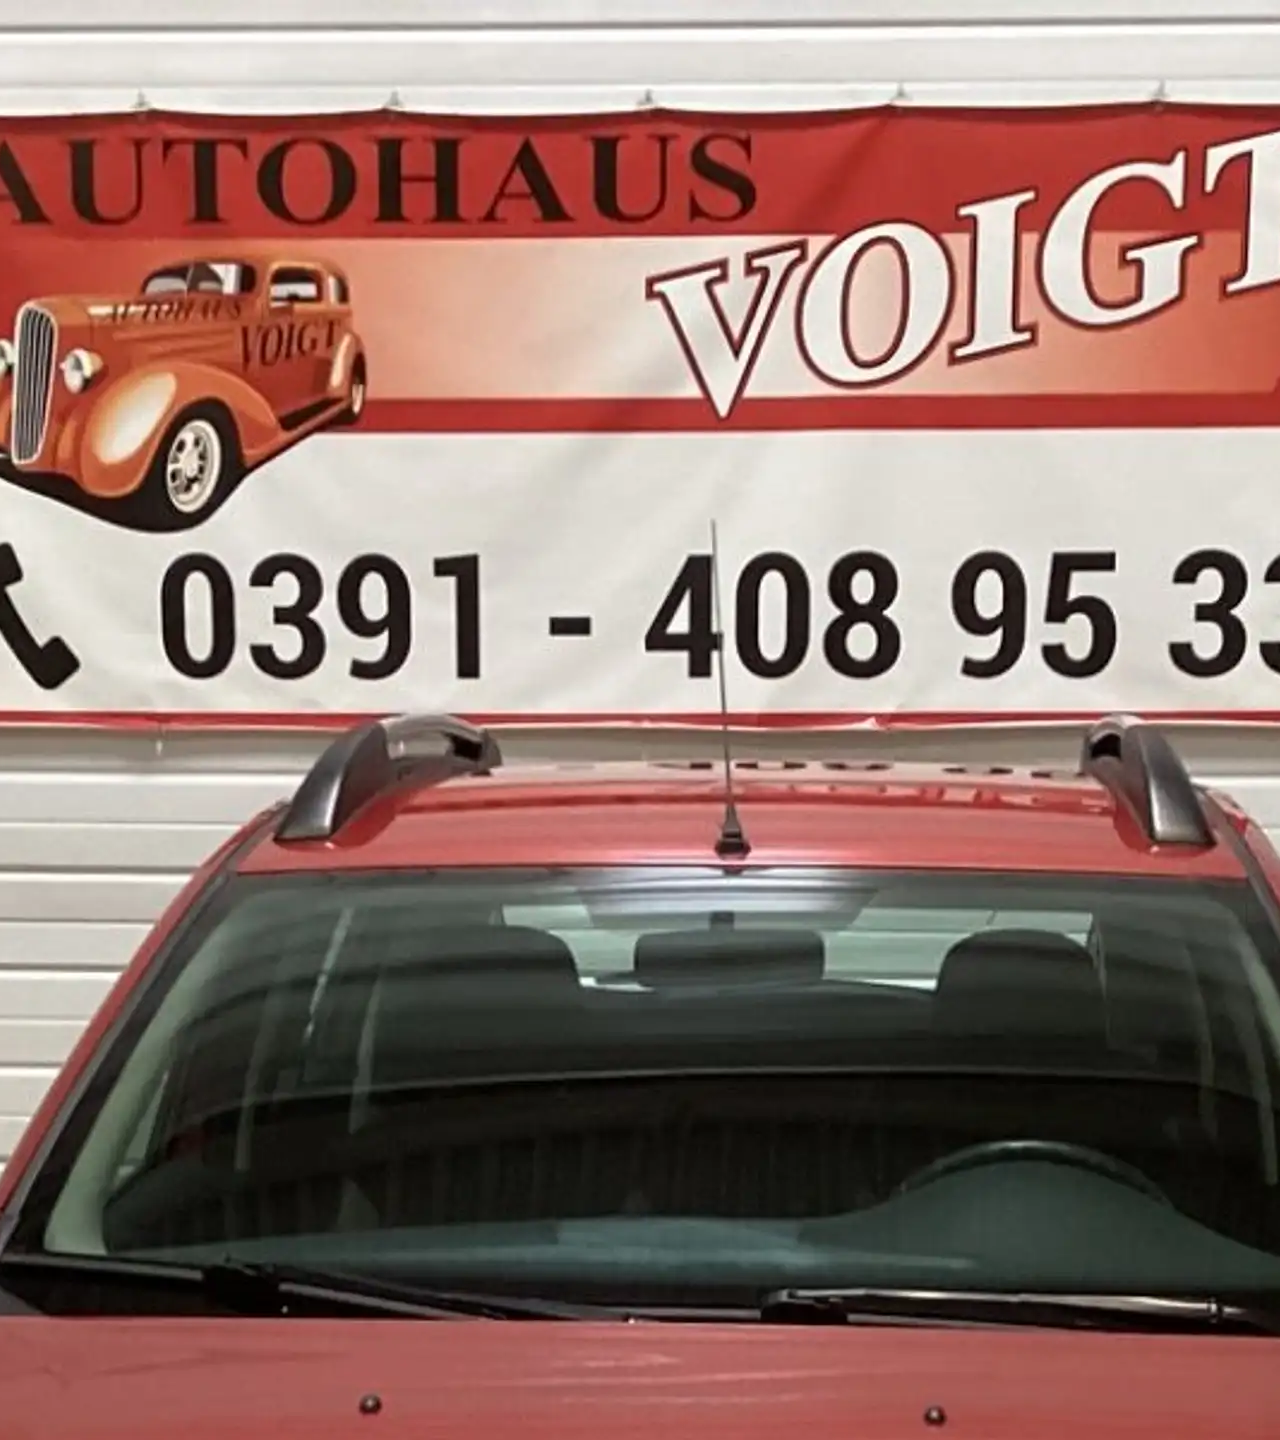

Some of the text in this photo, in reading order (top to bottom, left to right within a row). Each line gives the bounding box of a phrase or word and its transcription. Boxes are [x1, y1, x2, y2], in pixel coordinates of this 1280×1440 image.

[239, 319, 340, 372] VOIGT
[160, 553, 481, 680] 0391
[644, 550, 902, 679] 408
[951, 550, 1118, 678] 95
